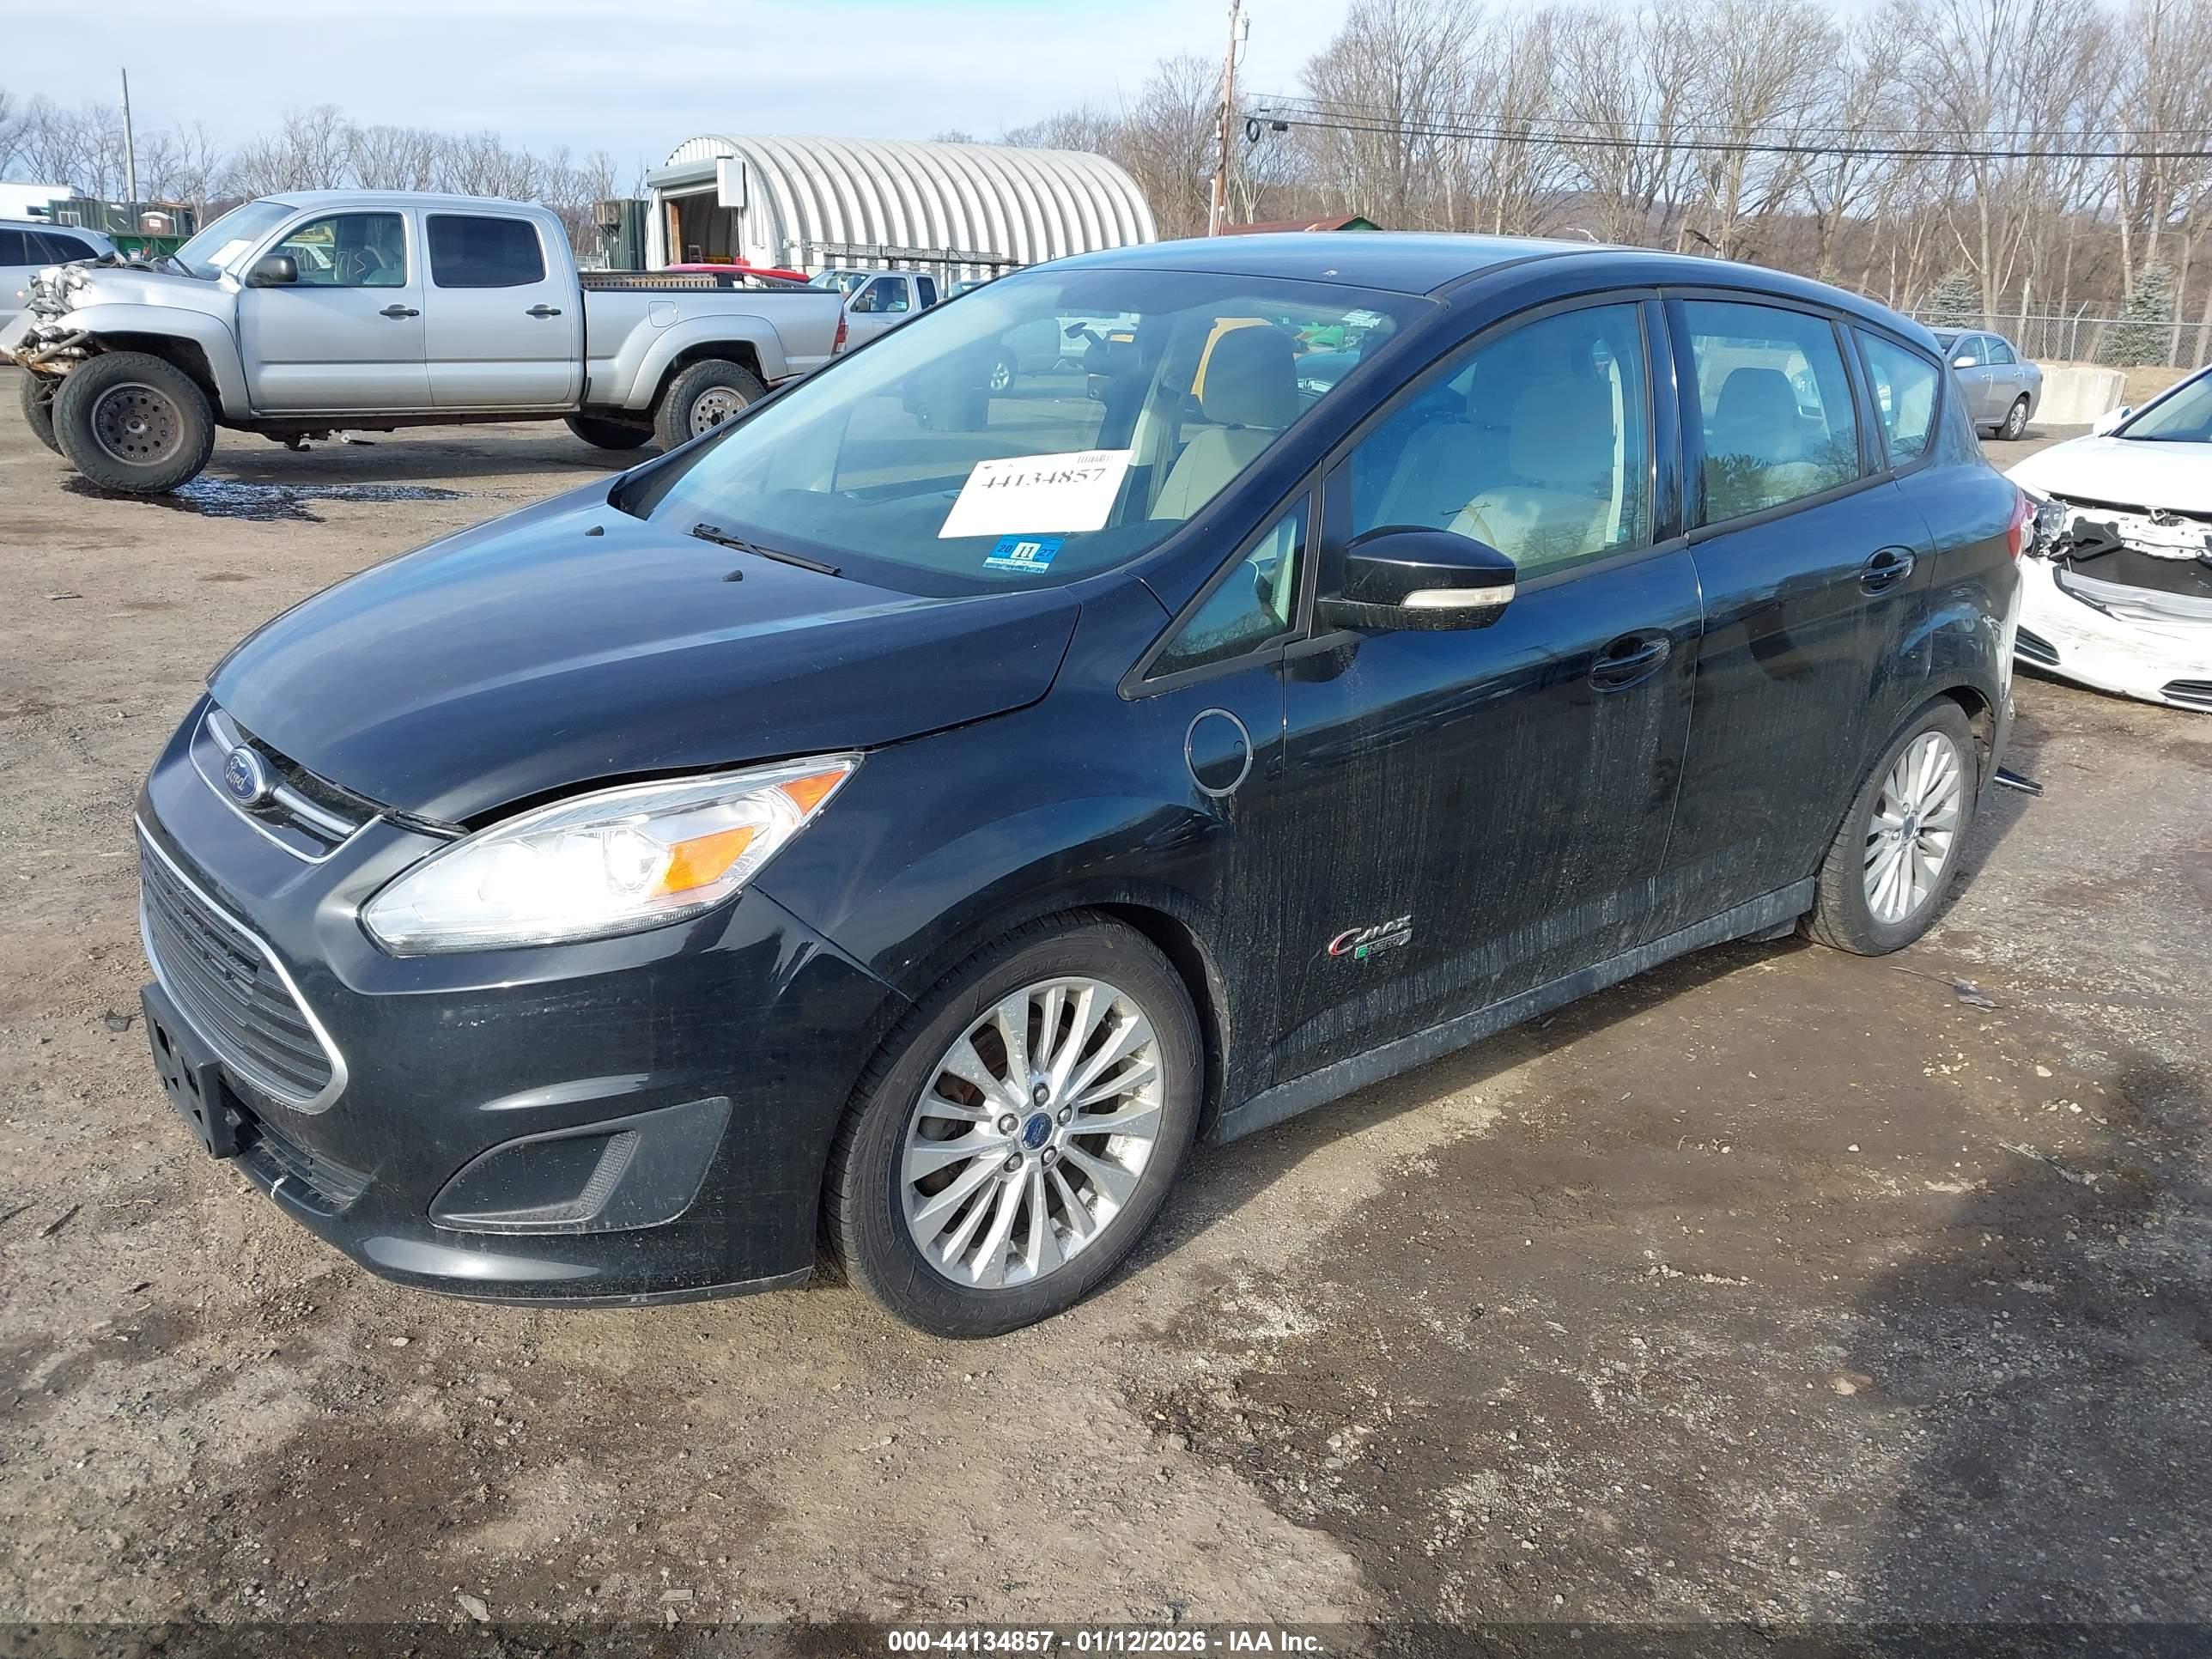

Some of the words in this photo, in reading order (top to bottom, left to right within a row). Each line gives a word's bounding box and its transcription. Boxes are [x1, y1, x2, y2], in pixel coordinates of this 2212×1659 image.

[981, 468, 1107, 488] 44134857
[998, 544, 1012, 553] 20
[1017, 546, 1034, 558] 11
[226, 756, 248, 792] Ford
